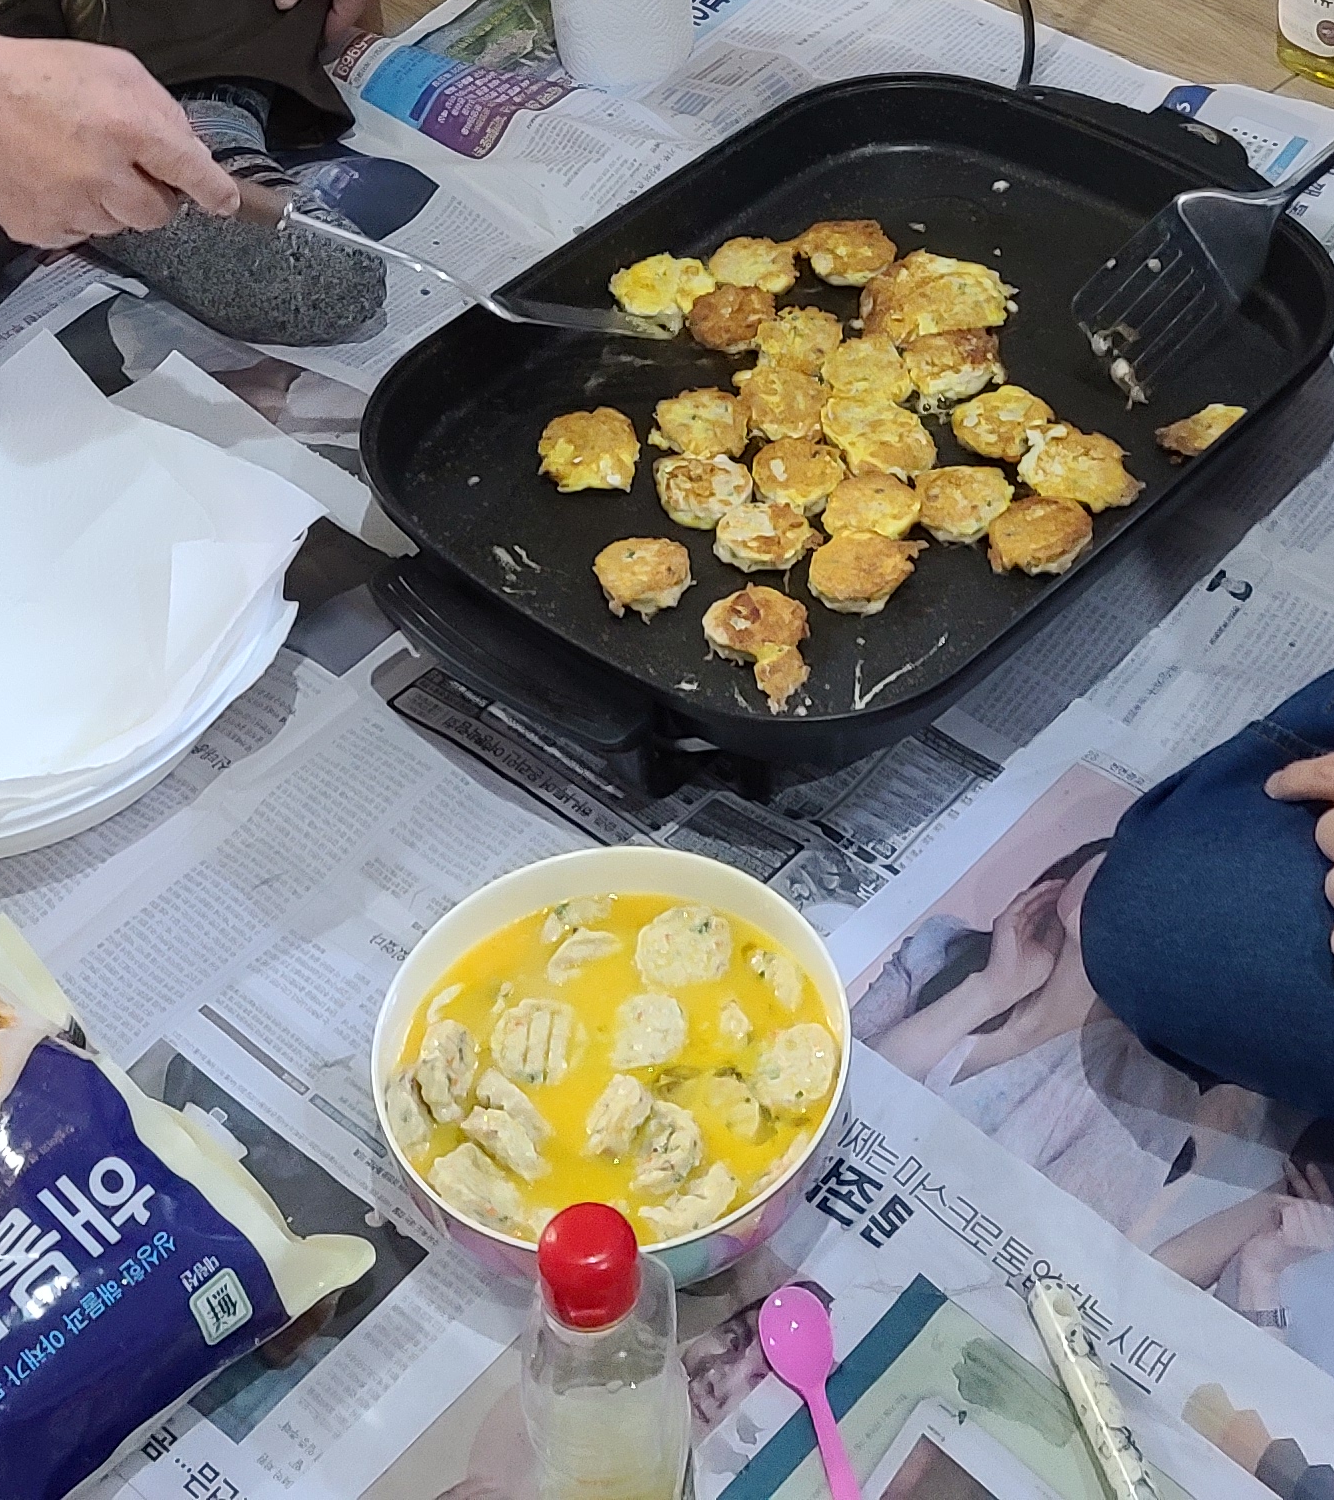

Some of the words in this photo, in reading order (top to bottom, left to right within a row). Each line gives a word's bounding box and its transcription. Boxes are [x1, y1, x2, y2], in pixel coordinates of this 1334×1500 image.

[116, 1228, 177, 1287] 싱싱한
[177, 1251, 221, 1292] 대림선
[885, 1154, 1008, 1257] 마스크로
[1103, 1318, 1177, 1385] 시대
[59, 1276, 124, 1337] 해물과
[2, 1325, 67, 1387] 야채가
